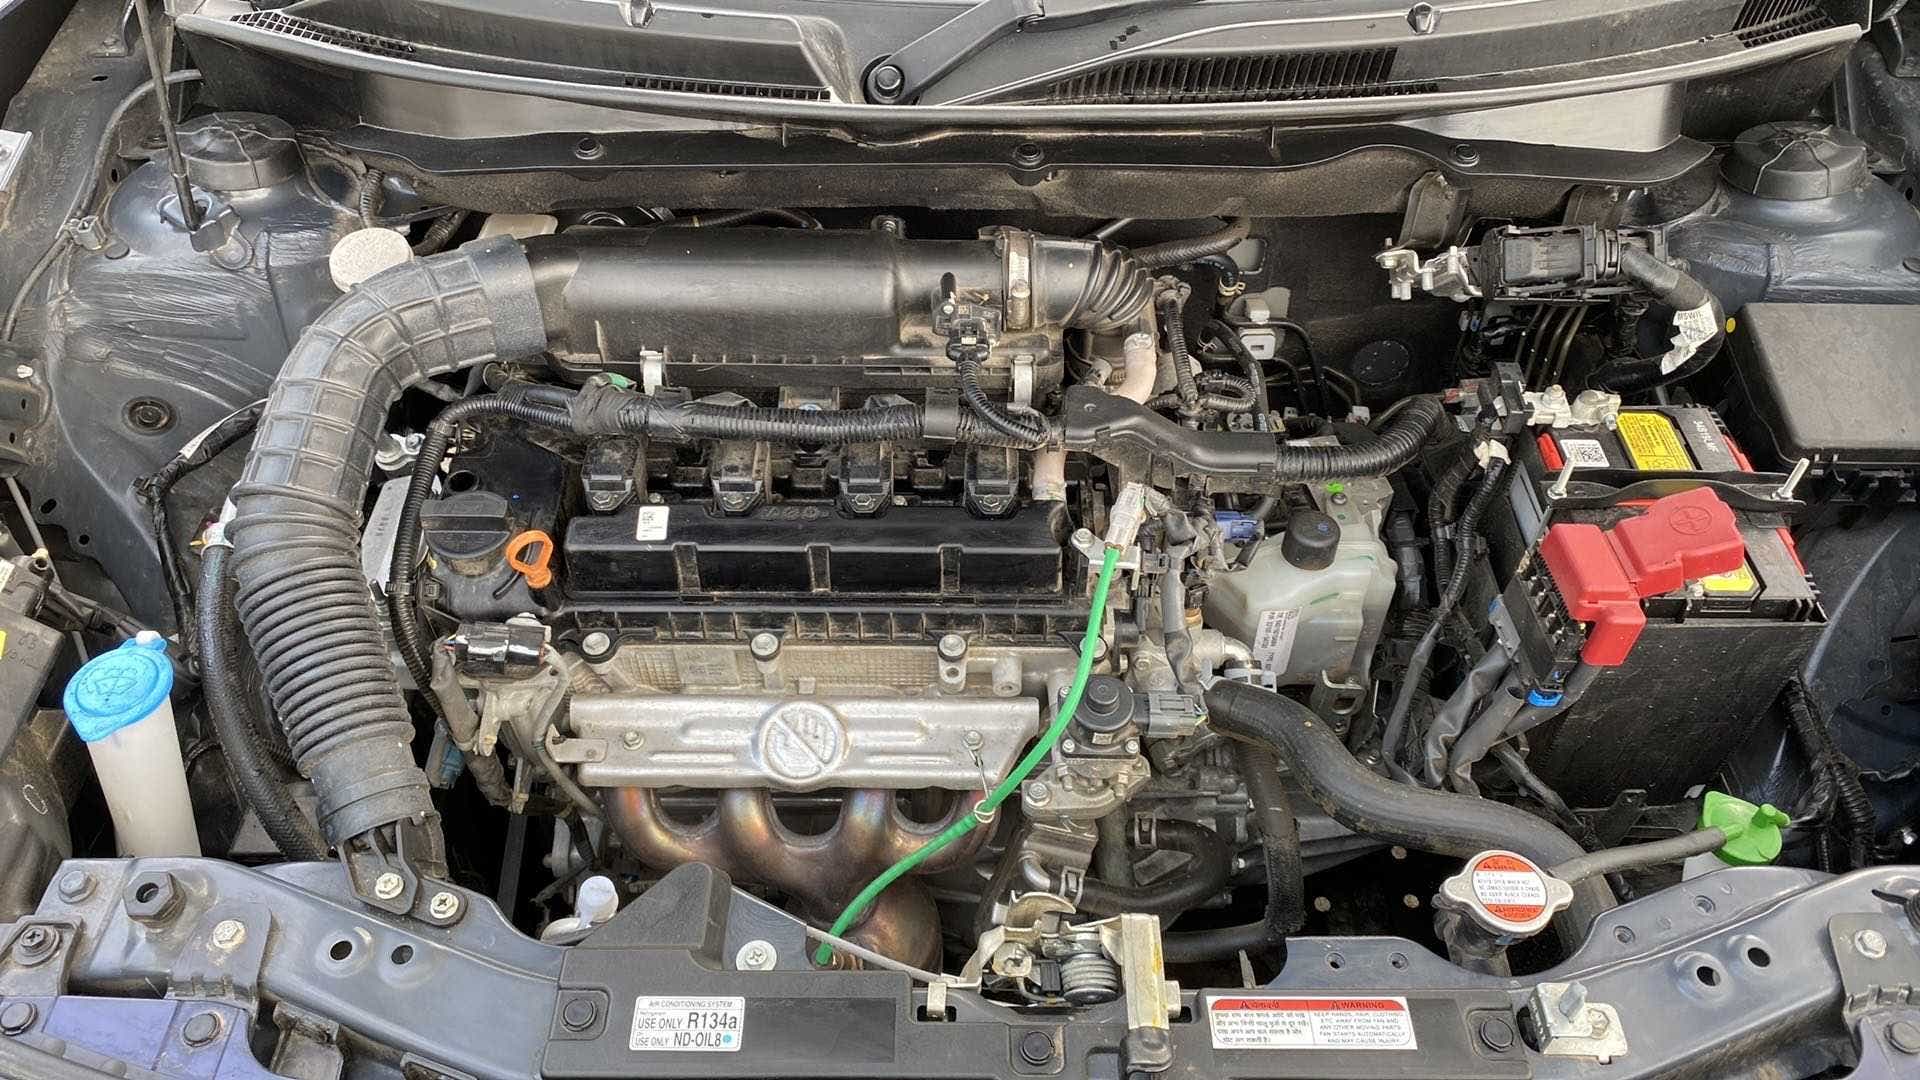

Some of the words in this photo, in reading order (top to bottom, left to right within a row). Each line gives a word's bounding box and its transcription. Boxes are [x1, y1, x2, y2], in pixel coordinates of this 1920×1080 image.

[638, 1018, 656, 1029] USE
[659, 1018, 683, 1029] ONLY
[688, 1012, 737, 1029] R134a
[636, 1037, 649, 1046] USE
[651, 1037, 669, 1046] ONLY
[674, 1032, 721, 1046] ND-OIL8
